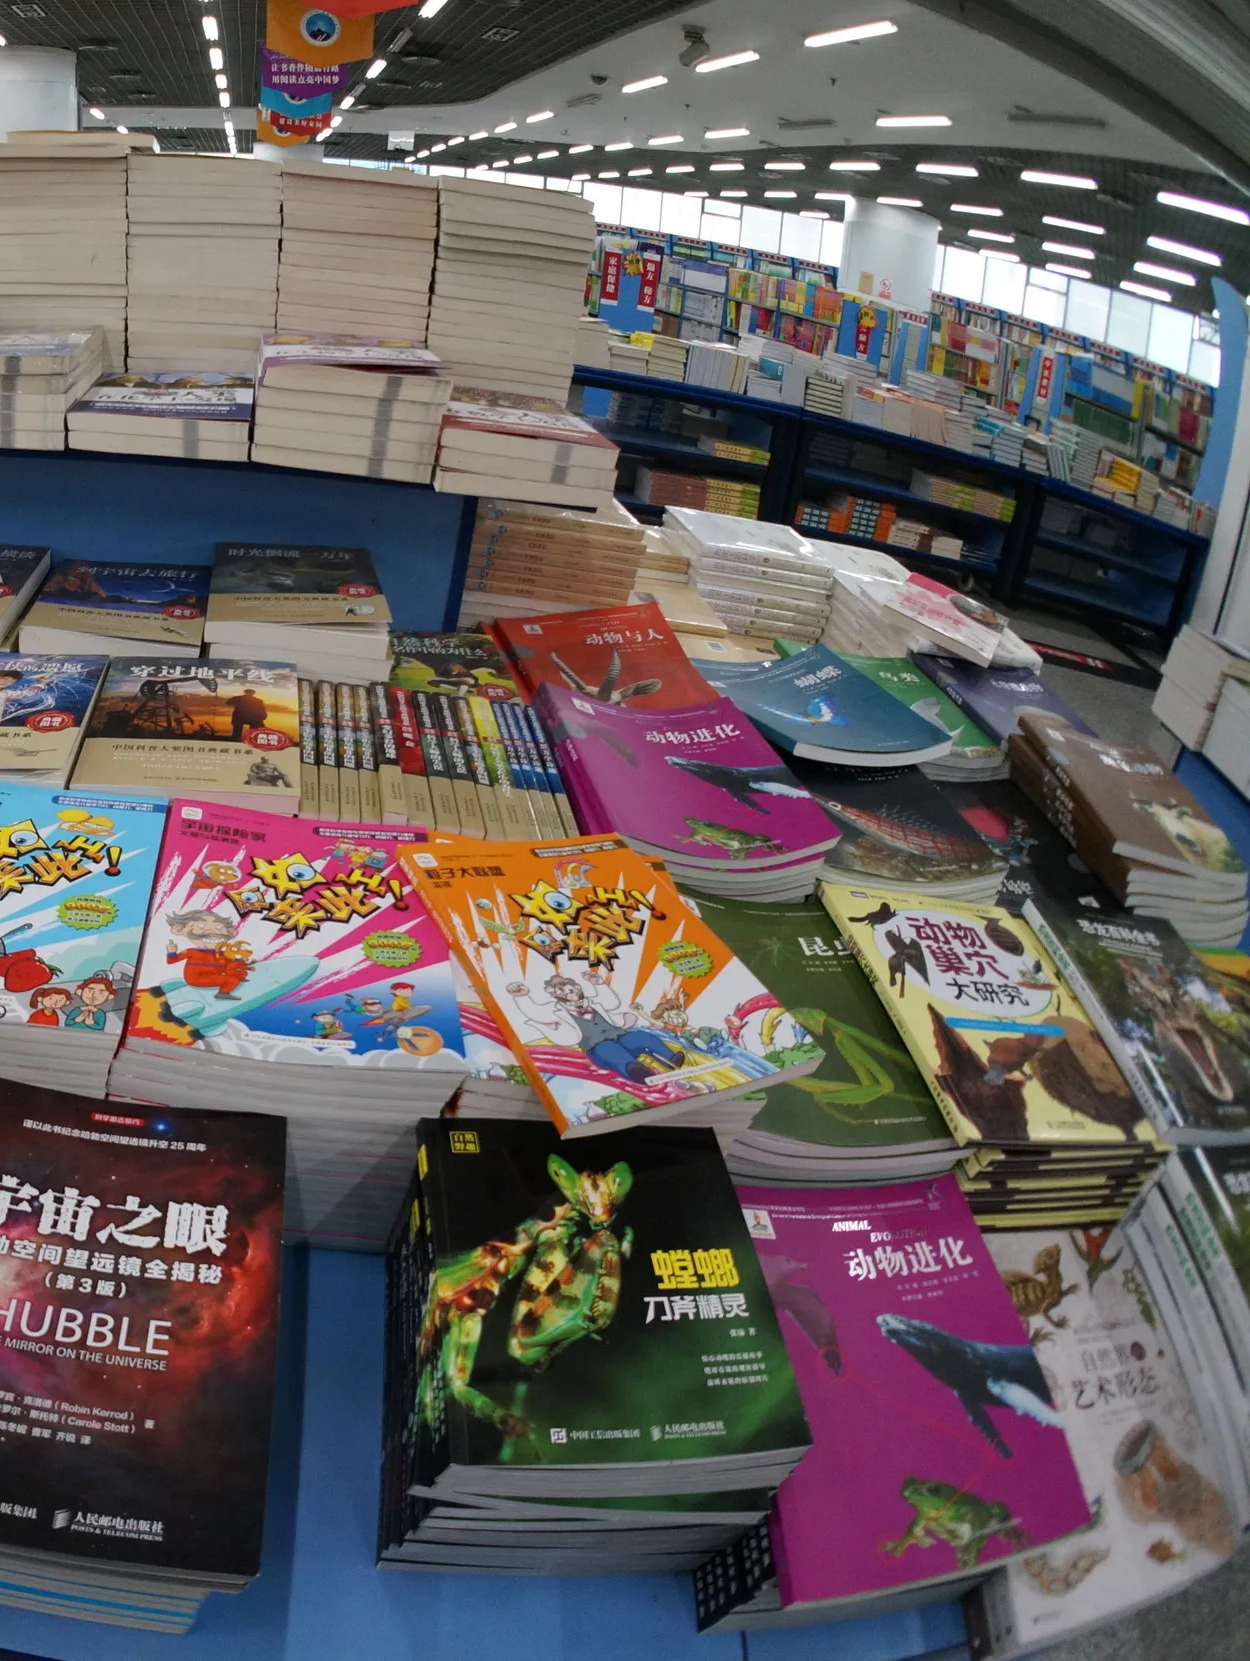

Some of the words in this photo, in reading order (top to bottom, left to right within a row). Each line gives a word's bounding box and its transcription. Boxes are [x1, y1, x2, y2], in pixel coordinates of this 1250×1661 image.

[605, 255, 618, 294] 家庭保健
[585, 628, 664, 647] 动物与人
[130, 665, 276, 683] 穿过地平线
[793, 666, 842, 688] 蝴蝶
[878, 669, 921, 684] 鸟类
[644, 723, 741, 745] 动物进化
[424, 865, 506, 881] 粒子大联盟
[905, 917, 987, 950] 动物
[930, 946, 1010, 981] 巢穴
[946, 979, 1029, 1007] 大研究
[169, 1140, 185, 1151] 25
[185, 1141, 208, 1153] 周年
[832, 1219, 872, 1232] ANIMAL
[650, 1248, 741, 1290] 螳螂
[842, 1235, 974, 1282] 动物进化
[643, 1292, 750, 1325] 刀斧精灵
[4, 1333, 55, 1356] MIRROR
[55, 1345, 78, 1359] ON
[78, 1348, 103, 1364] THE
[104, 1351, 168, 1372] UNIVERSE
[664, 1419, 725, 1434] 人民邮电出版社
[73, 1510, 164, 1534] 人民邮电出版社
